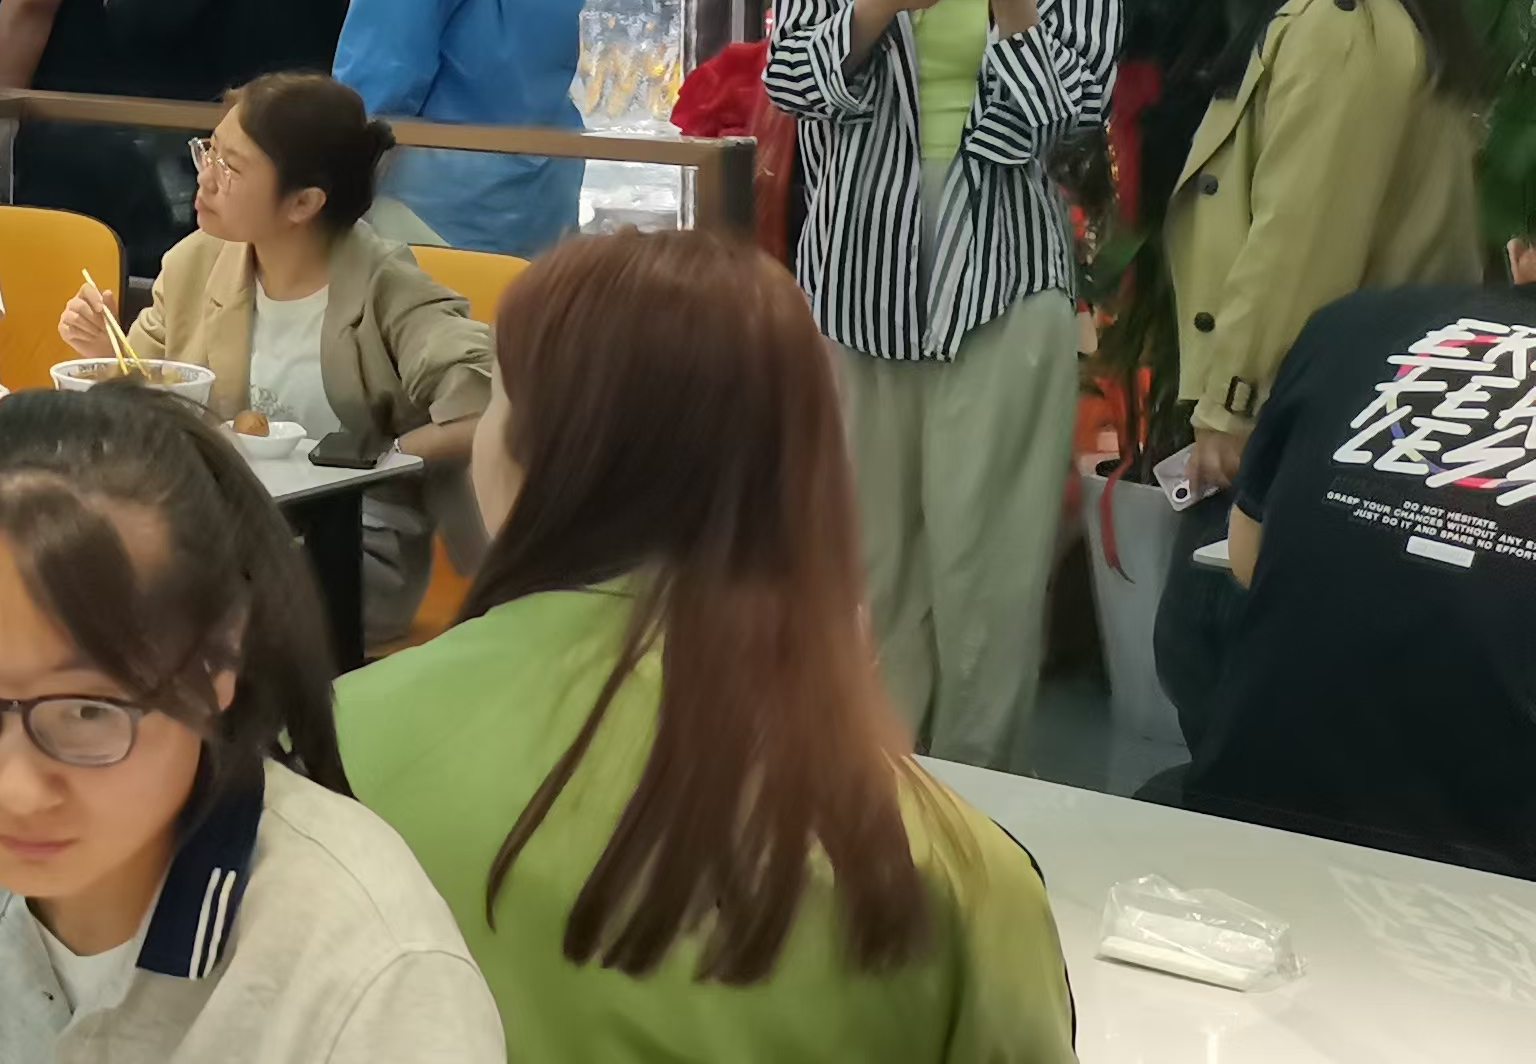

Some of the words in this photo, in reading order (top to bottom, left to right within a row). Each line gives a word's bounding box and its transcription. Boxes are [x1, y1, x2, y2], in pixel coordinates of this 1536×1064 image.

[1362, 500, 1392, 515] YOUR
[1393, 507, 1443, 528] CHANCES
[1446, 520, 1496, 540] WITHOUT
[1498, 534, 1523, 547] ANY
[1403, 500, 1419, 512] DO
[1421, 504, 1444, 517] NOT
[1353, 509, 1380, 522] JUST
[1381, 515, 1398, 527] DO
[1400, 519, 1413, 530] IT
[1414, 523, 1437, 536] AND
[1439, 528, 1475, 546] SPARE
[1476, 538, 1493, 550] NO
